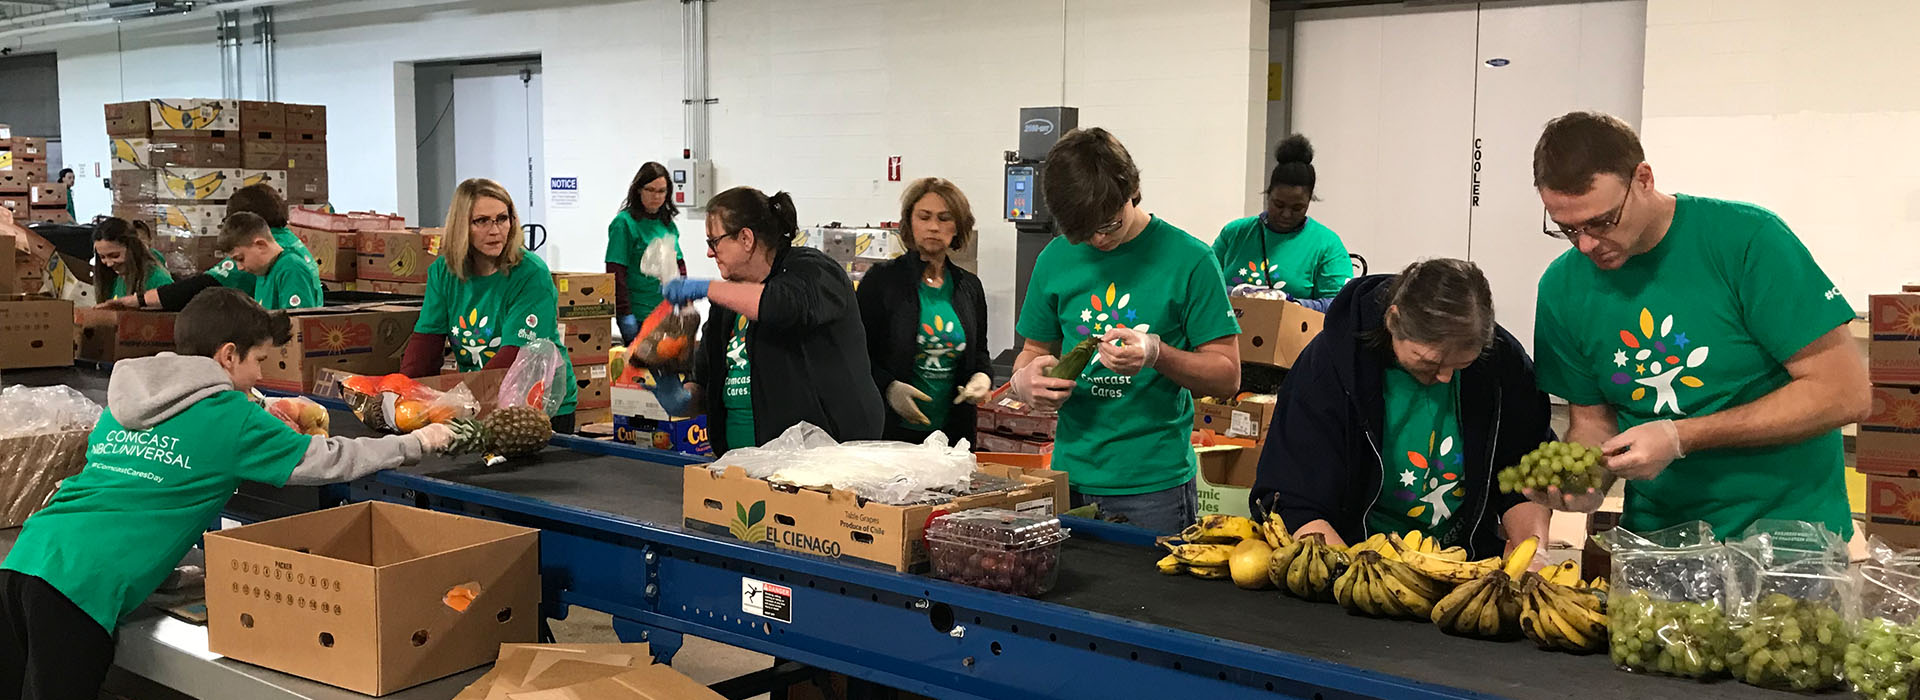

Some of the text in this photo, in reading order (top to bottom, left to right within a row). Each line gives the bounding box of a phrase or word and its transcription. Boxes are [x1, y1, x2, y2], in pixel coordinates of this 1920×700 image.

[1472, 138, 1482, 207] COOLER
[551, 179, 576, 189] NOTICE
[106, 430, 180, 450] COMCAST
[91, 443, 191, 469] NBCUNIVERSAL
[92, 462, 164, 483] #ComcastCaresDay
[845, 510, 880, 525] Table Grapes
[840, 520, 862, 531] Produce
[870, 527, 885, 536] Chile
[766, 525, 841, 557] EL CIENAGO
[275, 561, 292, 570] PACKER
[768, 585, 790, 597] DANGER
